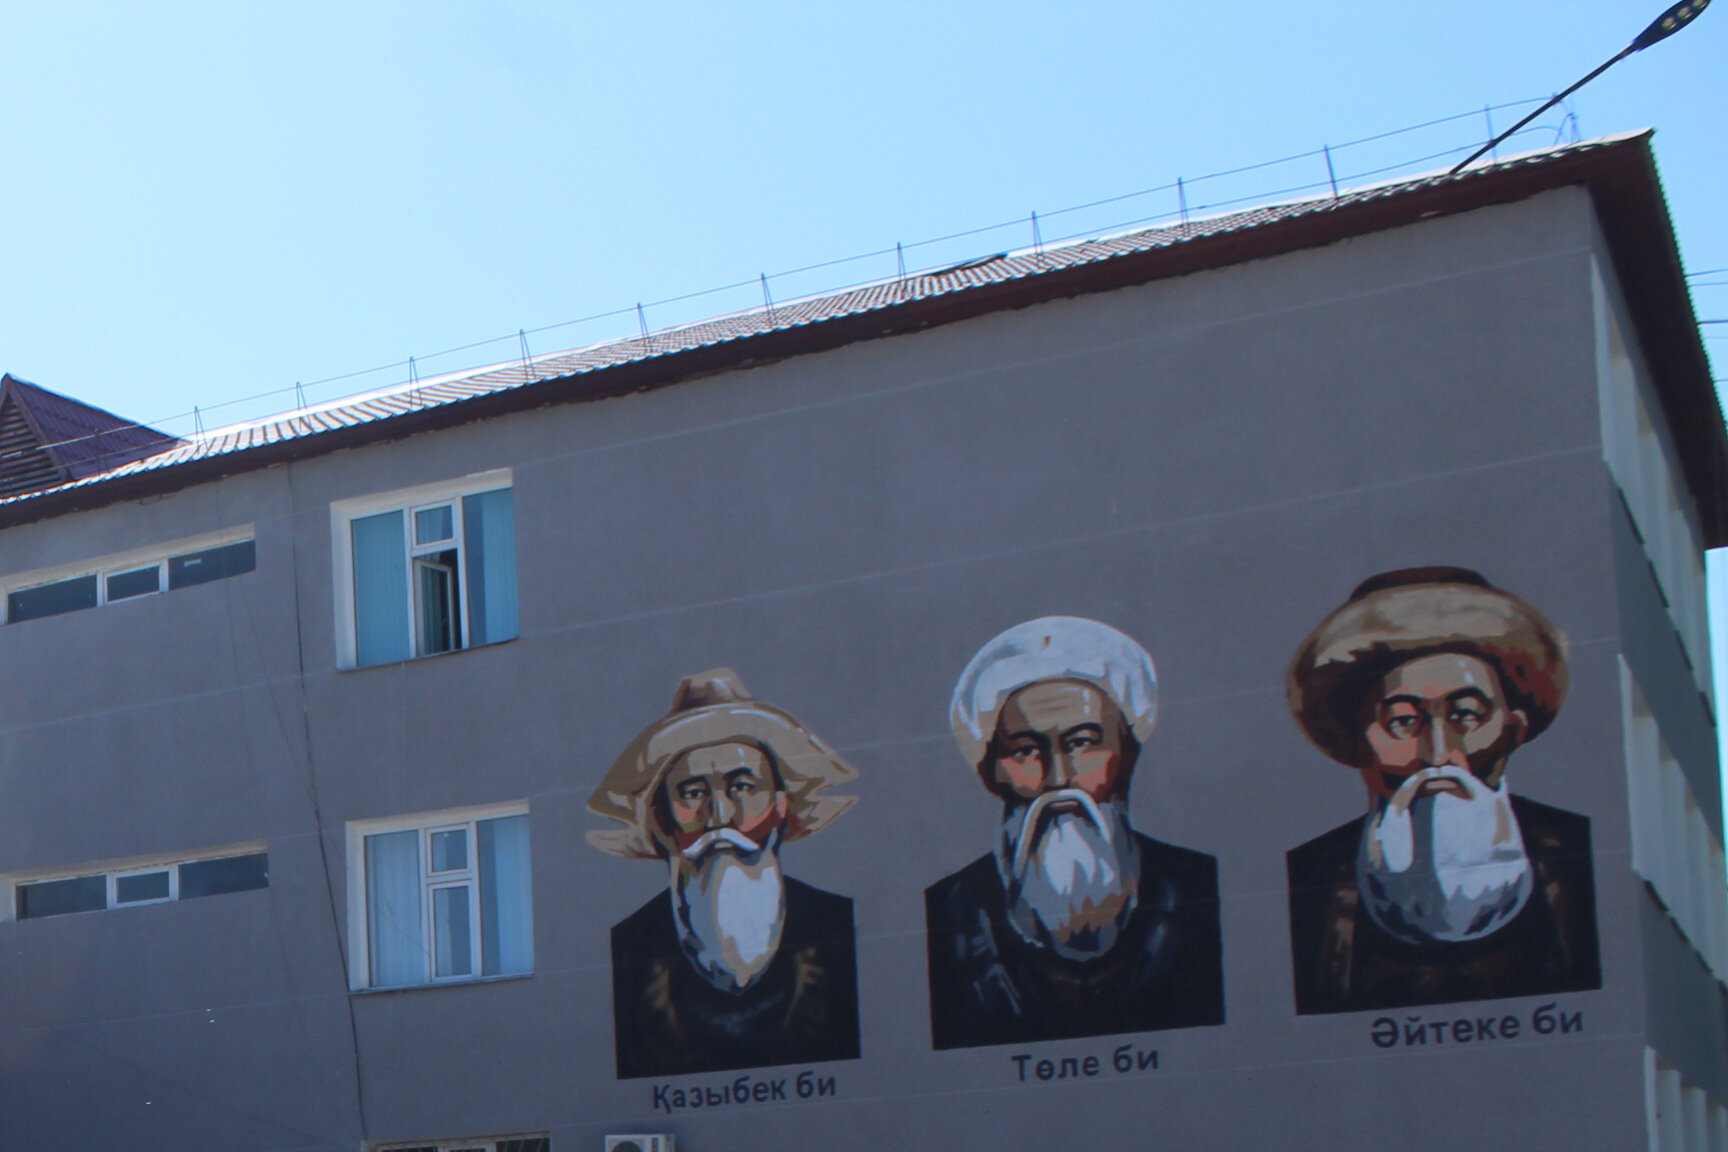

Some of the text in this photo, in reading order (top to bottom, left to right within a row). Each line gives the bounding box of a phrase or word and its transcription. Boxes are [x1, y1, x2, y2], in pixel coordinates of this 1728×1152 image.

[1370, 1003, 1584, 1049] Әйтеке би
[1011, 1044, 1160, 1082] Төле би
[652, 1070, 837, 1115] Қазыбек би
